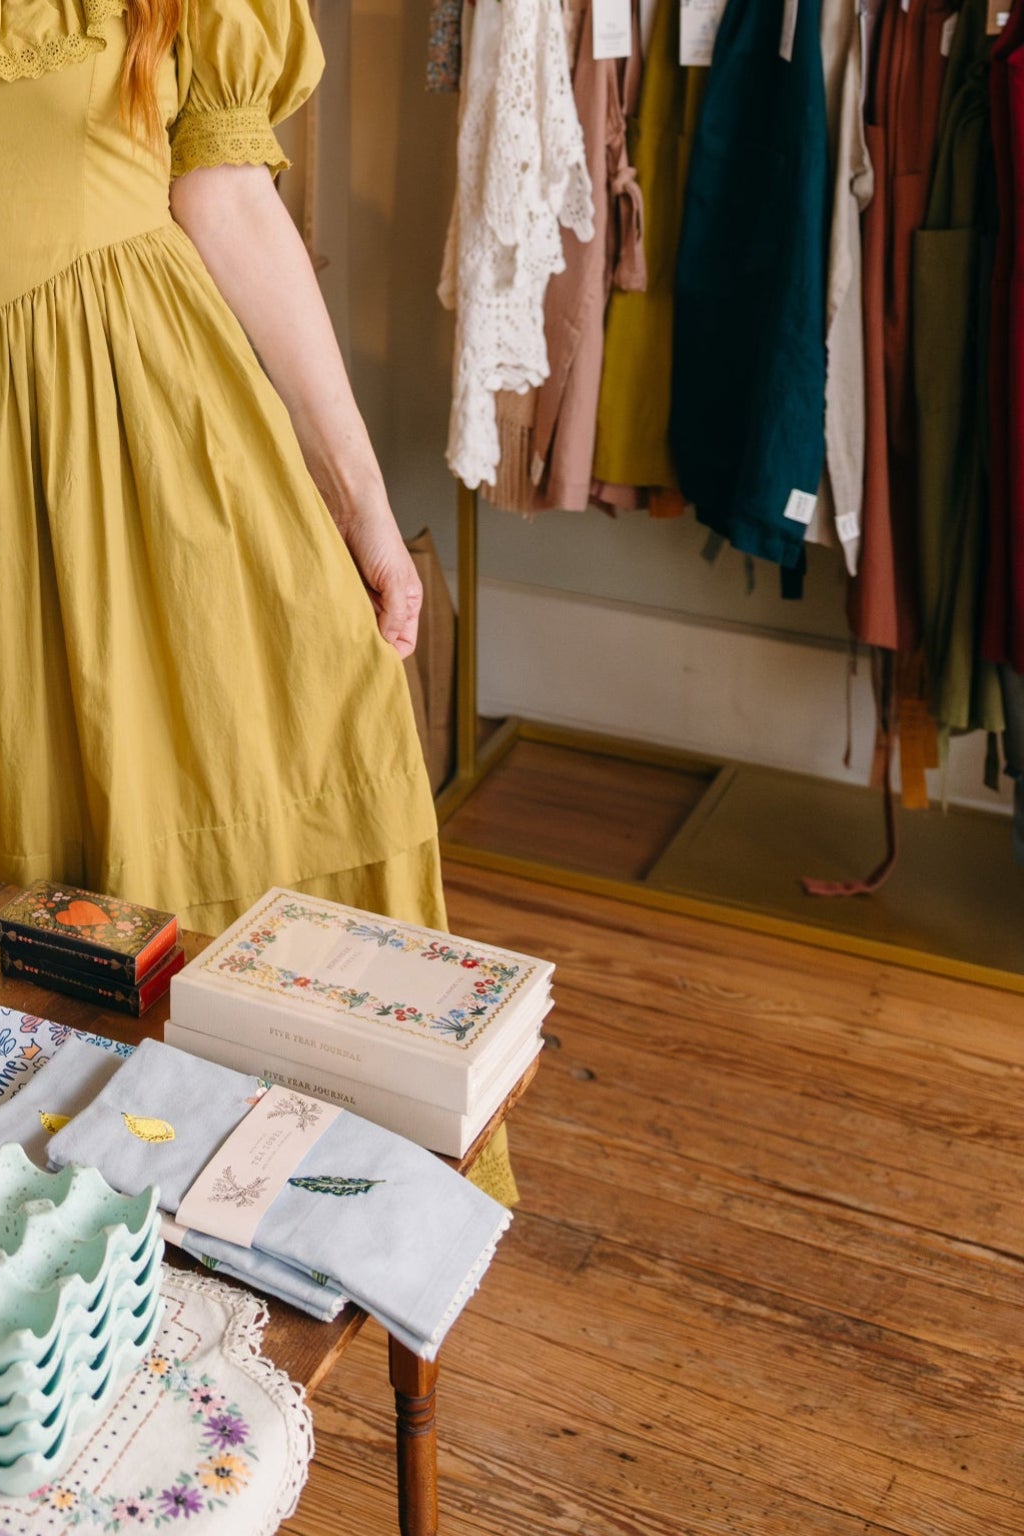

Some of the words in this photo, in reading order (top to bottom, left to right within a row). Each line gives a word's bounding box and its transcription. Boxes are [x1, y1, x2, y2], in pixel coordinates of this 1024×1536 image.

[269, 1027, 290, 1041] FIVE
[293, 1034, 317, 1049] YEAR
[319, 1042, 361, 1062] JOURNAL
[263, 1069, 285, 1083] FIVE
[287, 1077, 311, 1091] YEAR
[312, 1084, 356, 1105] JOURNAL
